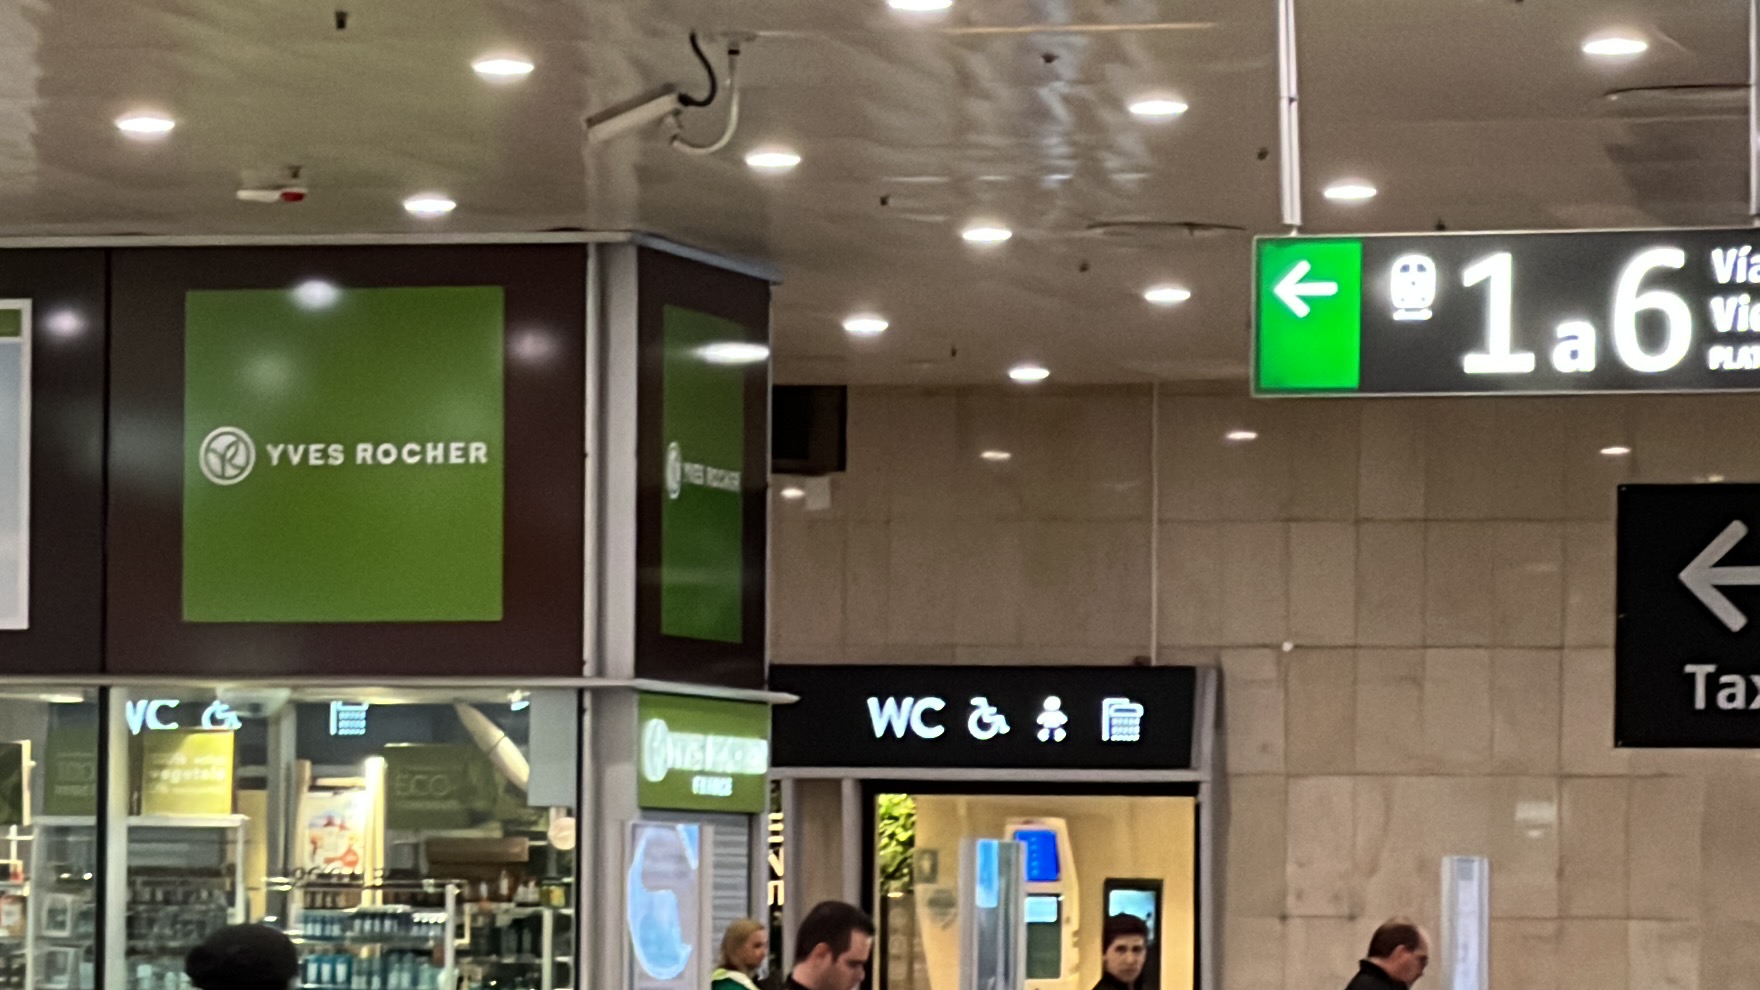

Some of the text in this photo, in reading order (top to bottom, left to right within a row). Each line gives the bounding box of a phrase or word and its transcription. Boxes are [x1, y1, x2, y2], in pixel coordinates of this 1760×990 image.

[1462, 246, 1693, 374] 1 a 6
[266, 441, 489, 466] YVES ROCHER
[867, 696, 946, 739] WC
